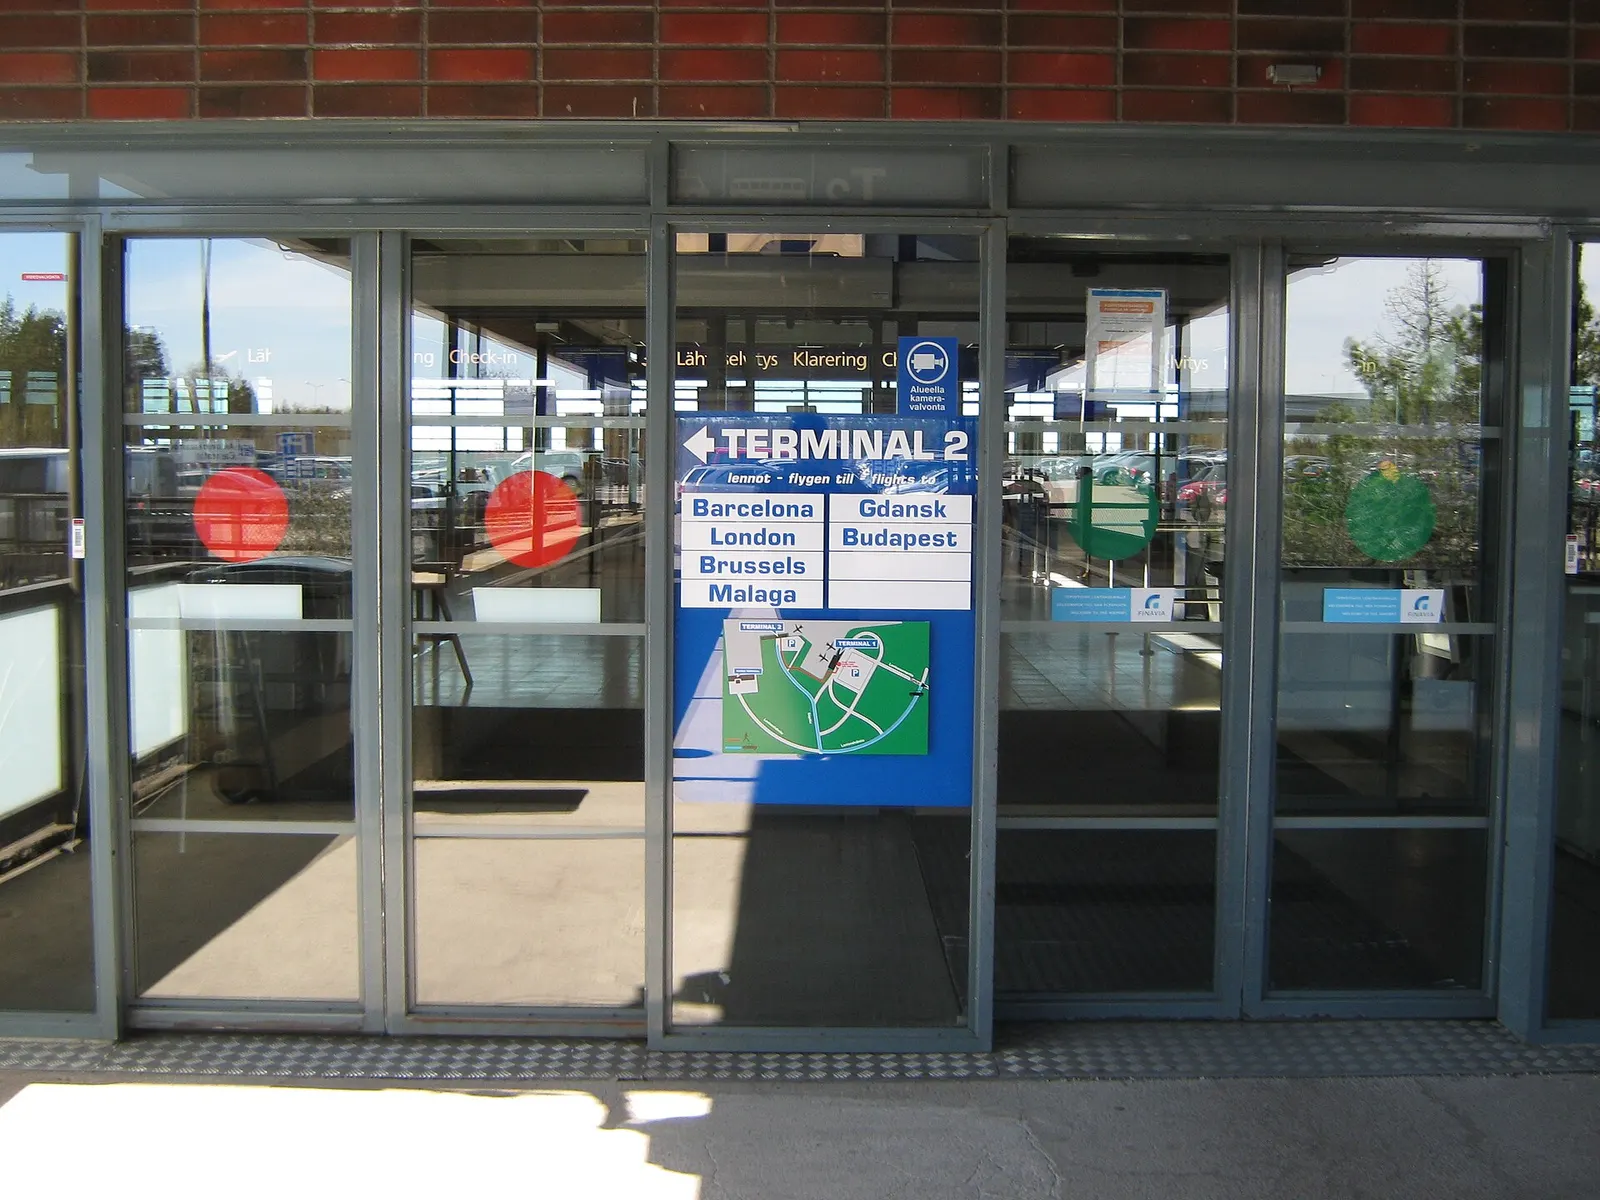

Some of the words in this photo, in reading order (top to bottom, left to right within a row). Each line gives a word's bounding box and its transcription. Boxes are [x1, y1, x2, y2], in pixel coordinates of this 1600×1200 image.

[449, 349, 517, 364] Check-in
[793, 350, 867, 371] Klarering
[910, 385, 945, 393] Alueella
[910, 394, 946, 402] kamera-
[909, 403, 946, 411] valvonta
[721, 428, 934, 460] TERMINAL
[944, 430, 968, 460] 2
[727, 472, 771, 484] lennot
[788, 472, 830, 486] flygen
[835, 472, 855, 484] till
[871, 473, 916, 487] flights
[692, 498, 814, 518] Barcelona
[858, 498, 948, 518] Gdansk
[710, 527, 796, 546] London
[842, 527, 957, 550] Budapest
[699, 555, 806, 575] Brussels
[709, 584, 797, 607] Malaga
